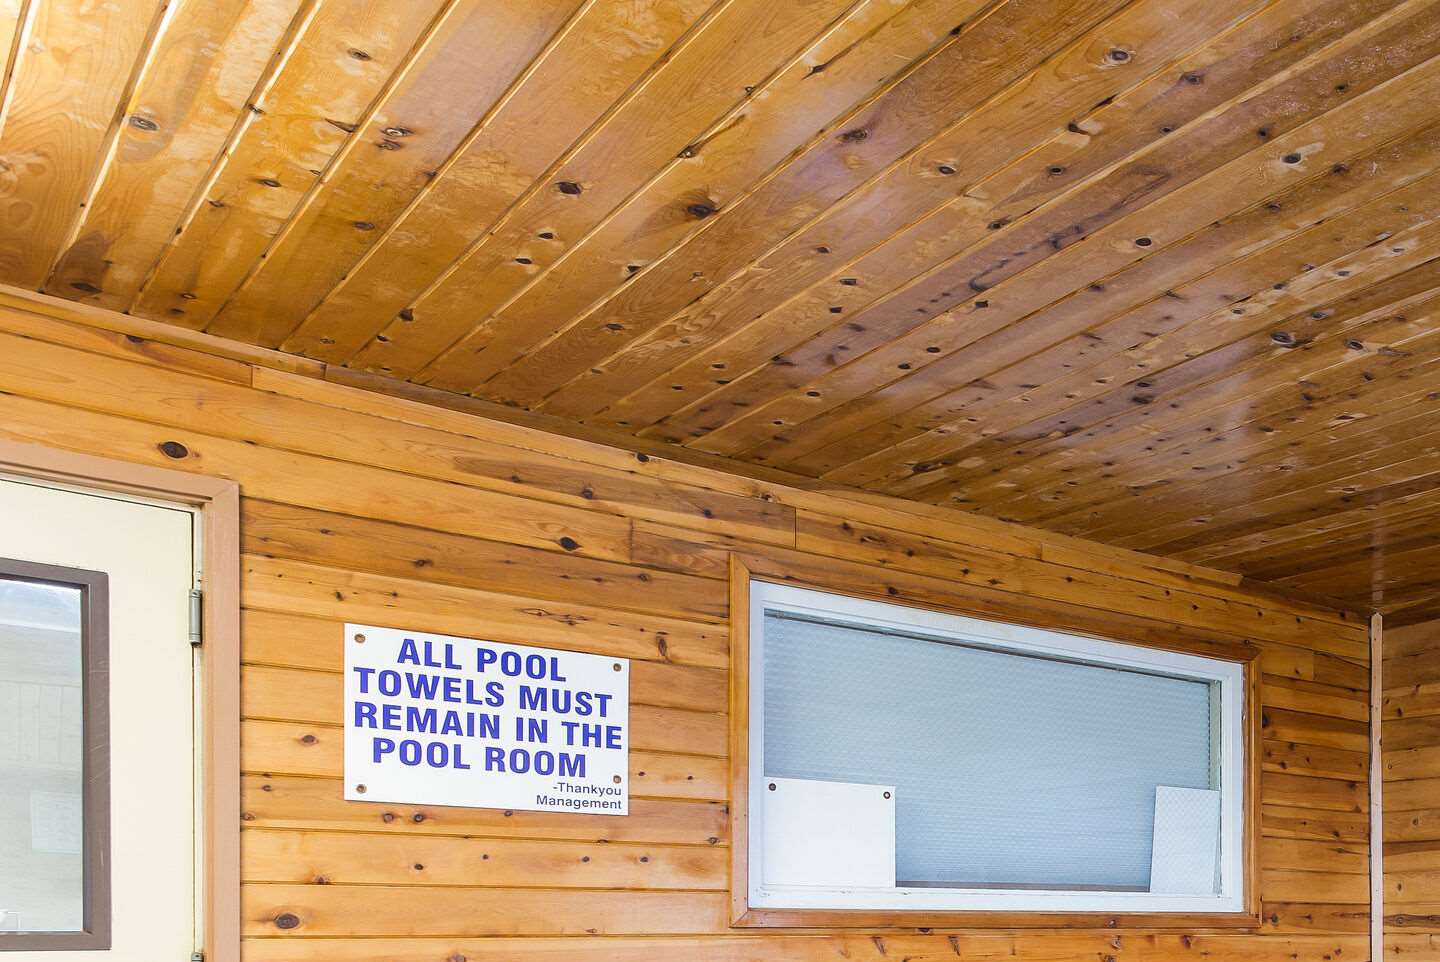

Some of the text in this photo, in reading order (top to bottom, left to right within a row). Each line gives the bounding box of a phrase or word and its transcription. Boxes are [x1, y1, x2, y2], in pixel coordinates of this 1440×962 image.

[397, 638, 566, 682] ALL POOL
[353, 667, 612, 717] TOWELS MUST
[354, 701, 622, 750] REMAIN IN THE
[373, 737, 586, 778] POOL ROOM
[536, 795, 621, 810] Management
